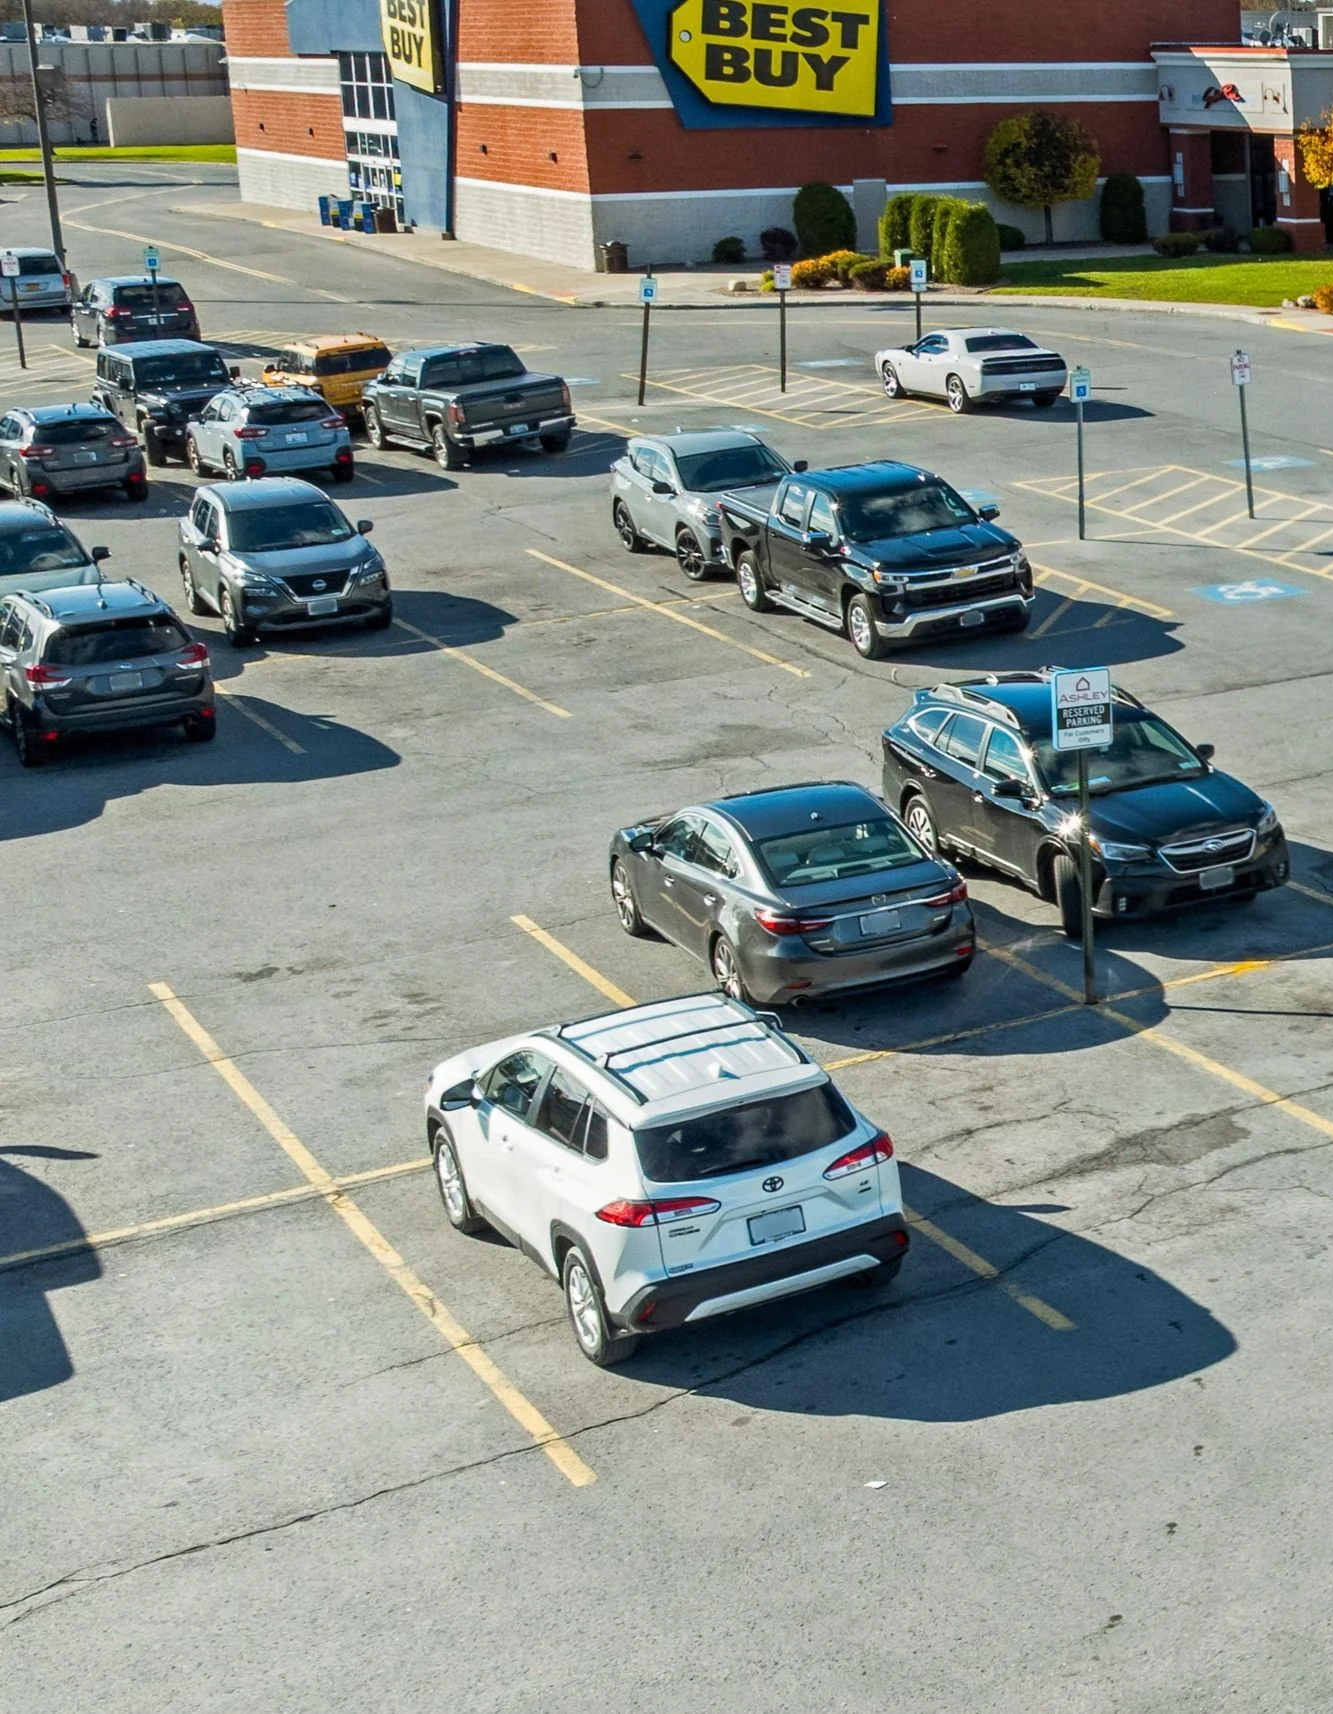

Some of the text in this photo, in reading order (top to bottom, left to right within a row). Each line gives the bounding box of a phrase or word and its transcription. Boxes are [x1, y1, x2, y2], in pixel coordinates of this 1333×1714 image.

[701, 0, 870, 50] BEST
[390, 26, 424, 67] BUY
[705, 43, 850, 91] BUY
[1058, 690, 1108, 704] ASHLEY
[1062, 705, 1105, 719] RESERVED
[1066, 715, 1103, 728] PARKING
